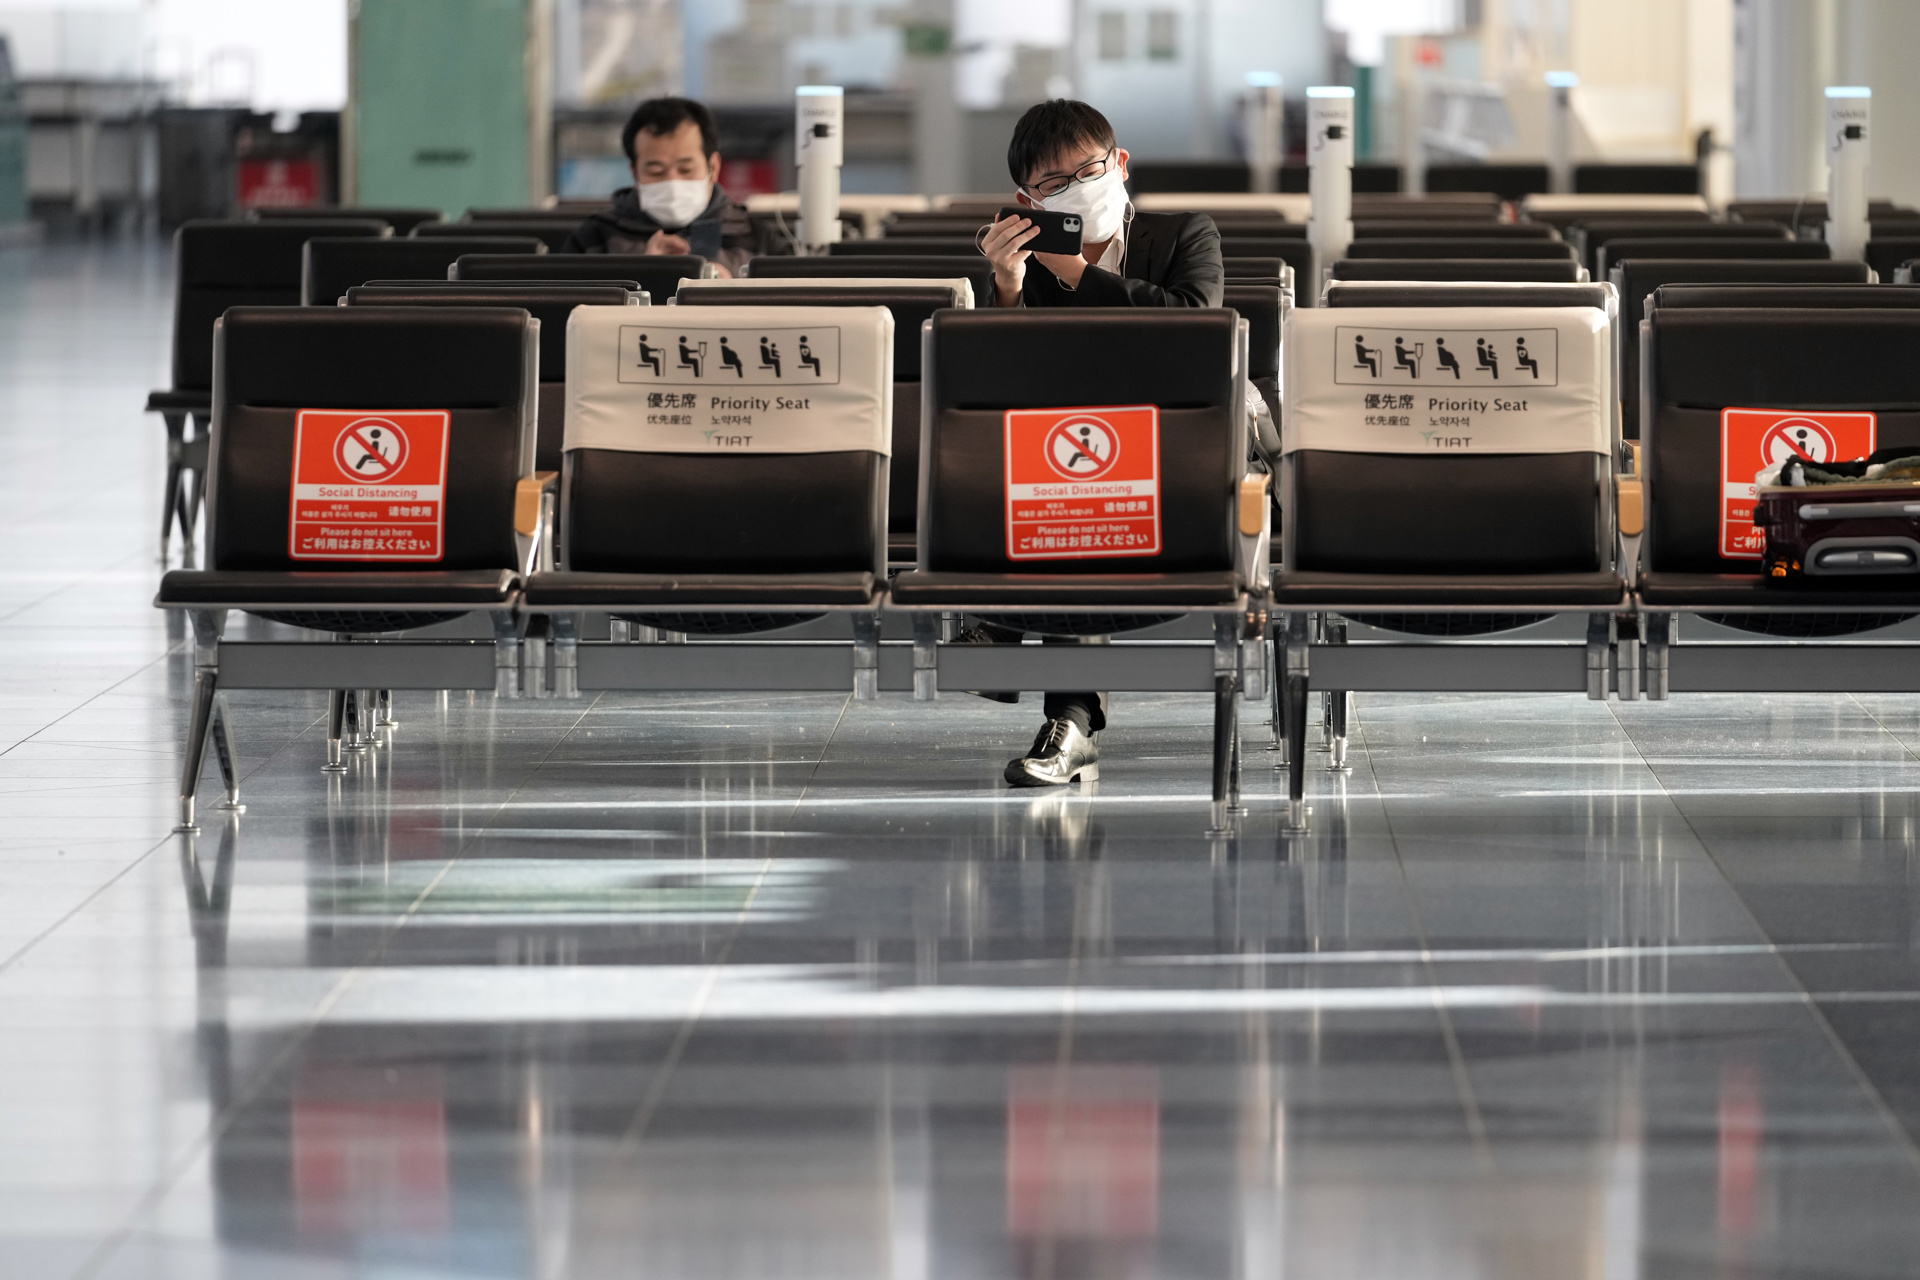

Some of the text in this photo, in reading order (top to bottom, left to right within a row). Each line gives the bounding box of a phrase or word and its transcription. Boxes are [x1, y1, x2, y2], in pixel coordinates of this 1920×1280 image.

[647, 393, 697, 409] 優先席
[711, 397, 810, 412] Priority Seat
[1364, 394, 1414, 410] 優先席
[1428, 398, 1528, 413] Priority Seat
[647, 414, 692, 425] 优先座位
[711, 414, 752, 425] 노약자석
[1365, 415, 1410, 426] 优先座位
[1428, 416, 1470, 427] 노약자석
[714, 435, 753, 447] TIAT
[1433, 437, 1472, 448] TIAT
[319, 487, 418, 500] Social Distancing
[1033, 484, 1132, 496] Social Distancing
[320, 527, 413, 537] Please do not sit here
[1037, 524, 1130, 535] Please do not sit here
[302, 537, 431, 550] ご利用はお控えください
[1020, 534, 1148, 549] ご利用はお控えください
